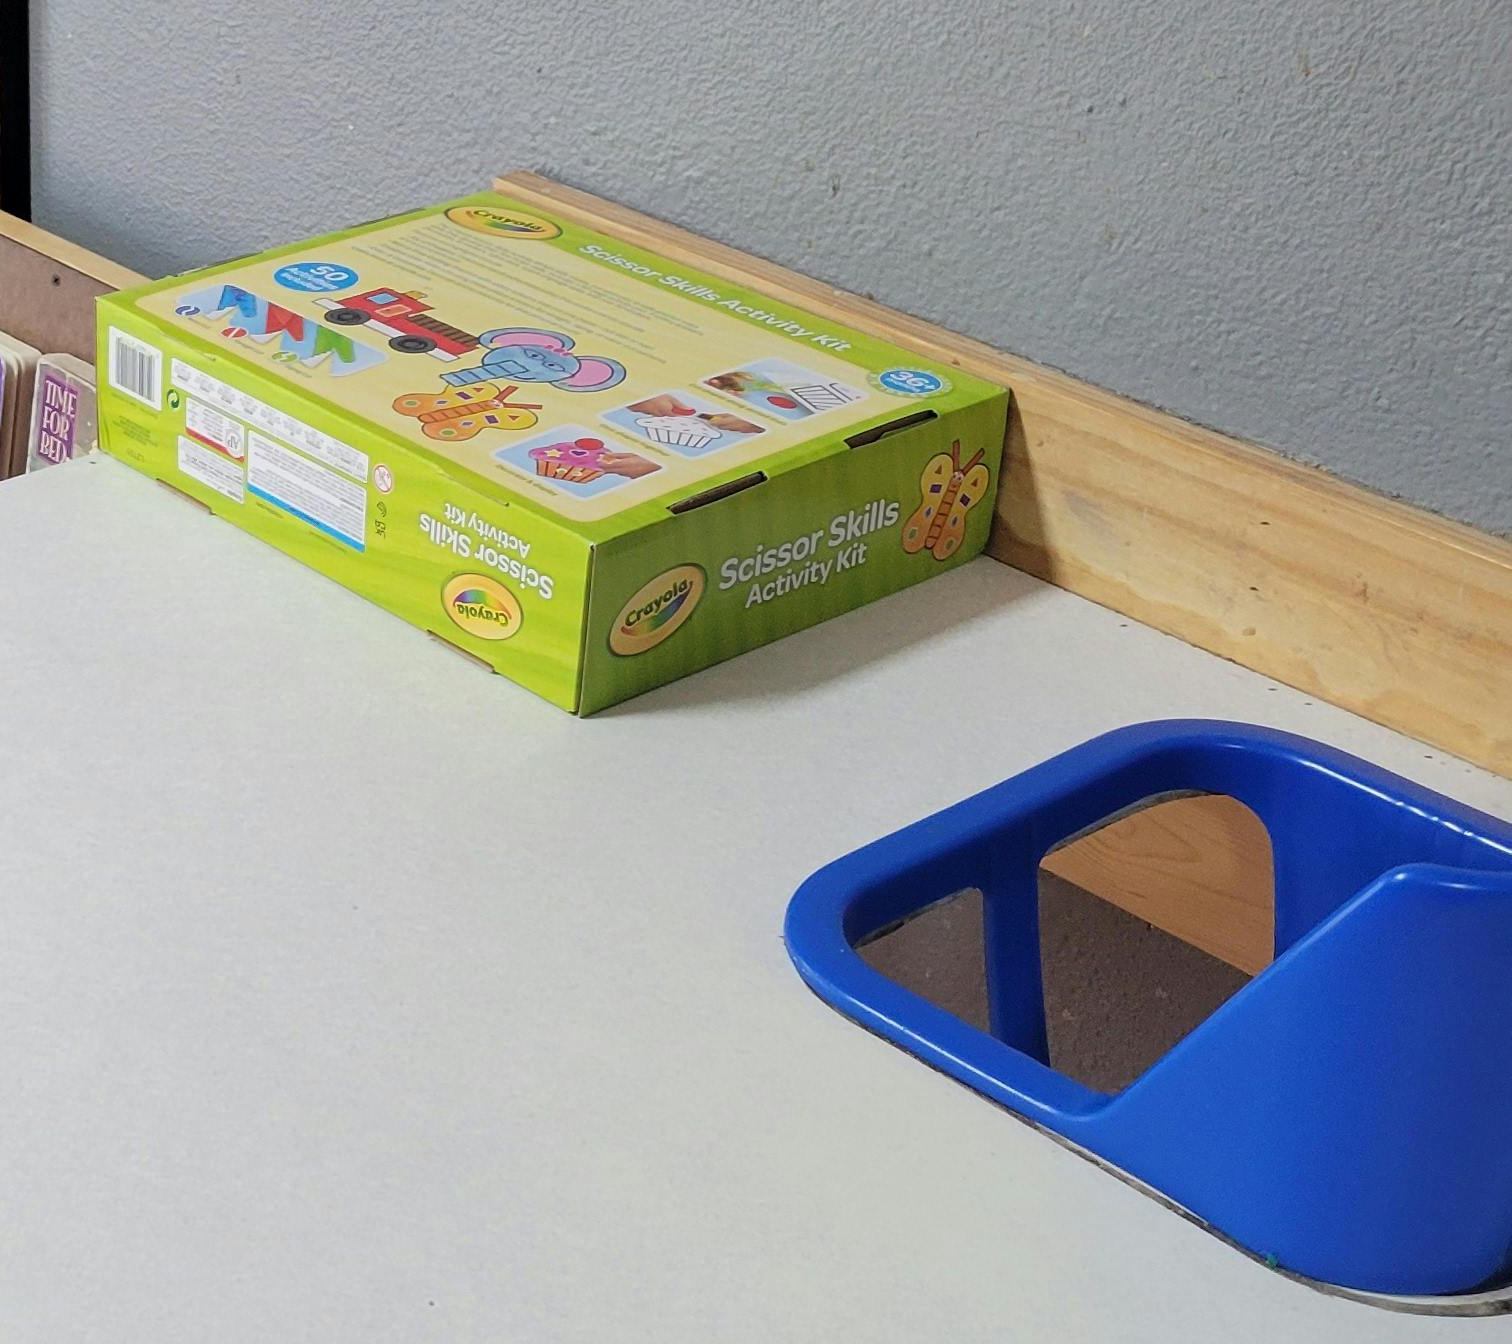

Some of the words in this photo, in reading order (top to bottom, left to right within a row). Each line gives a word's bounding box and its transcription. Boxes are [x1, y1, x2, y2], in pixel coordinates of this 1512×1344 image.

[472, 209, 543, 231] Crayola
[309, 265, 349, 282] 50
[578, 244, 662, 278] Scissor
[658, 274, 722, 303] Skills
[717, 298, 814, 338] Activity
[810, 333, 853, 353] Kit
[45, 379, 78, 418] TIME
[42, 405, 71, 441] FOR
[39, 430, 67, 464] BED
[419, 513, 471, 558] Skills
[443, 503, 466, 528] Kit
[468, 512, 531, 559] Activity
[718, 529, 824, 591] Scissor
[827, 498, 900, 548] Skills
[474, 543, 554, 600] Scissor
[744, 558, 833, 609] Activity
[836, 542, 868, 573] Kit
[456, 603, 509, 628] Crayola
[624, 578, 689, 627] Crayola
